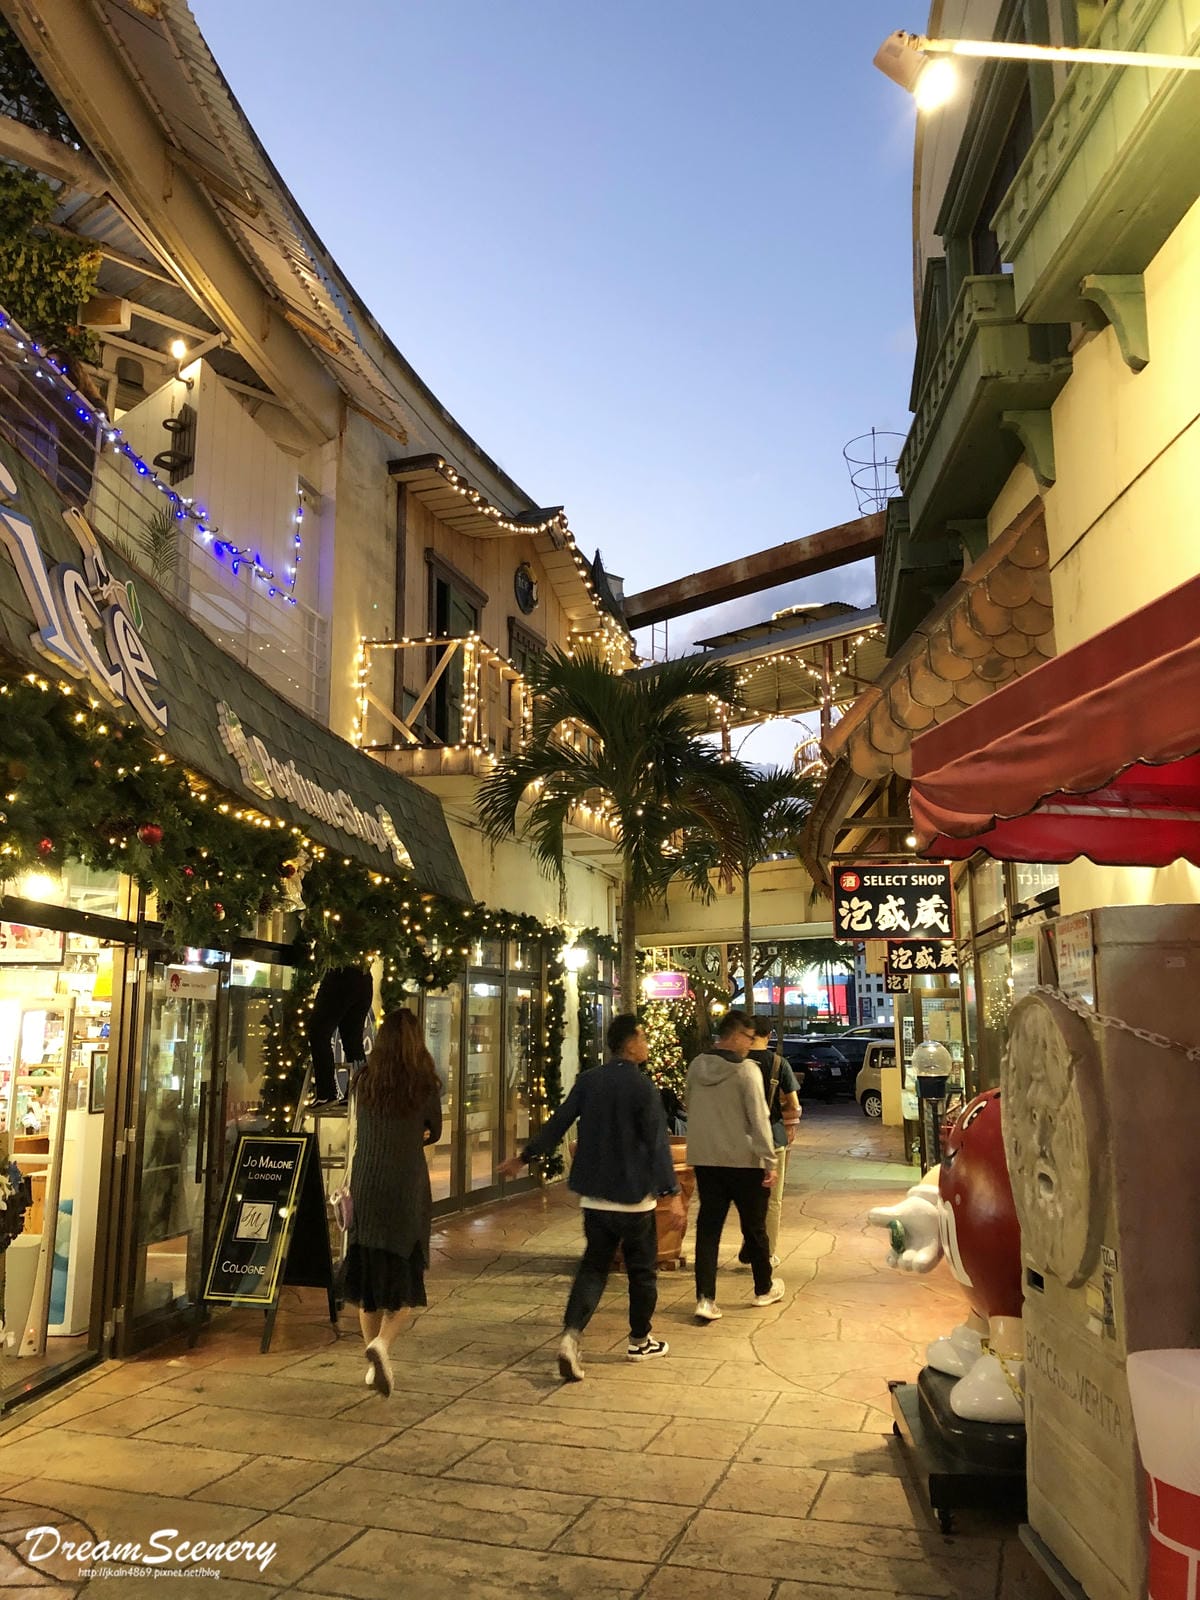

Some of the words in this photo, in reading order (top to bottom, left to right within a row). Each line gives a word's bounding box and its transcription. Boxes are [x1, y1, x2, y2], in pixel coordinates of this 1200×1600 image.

[843, 875, 856, 888] 酒
[863, 875, 908, 887] SELECT
[910, 874, 946, 886] SHOP
[259, 1156, 294, 1169] MALONE
[248, 1171, 282, 1182] LONDON
[221, 1260, 267, 1275] COLOGNE
